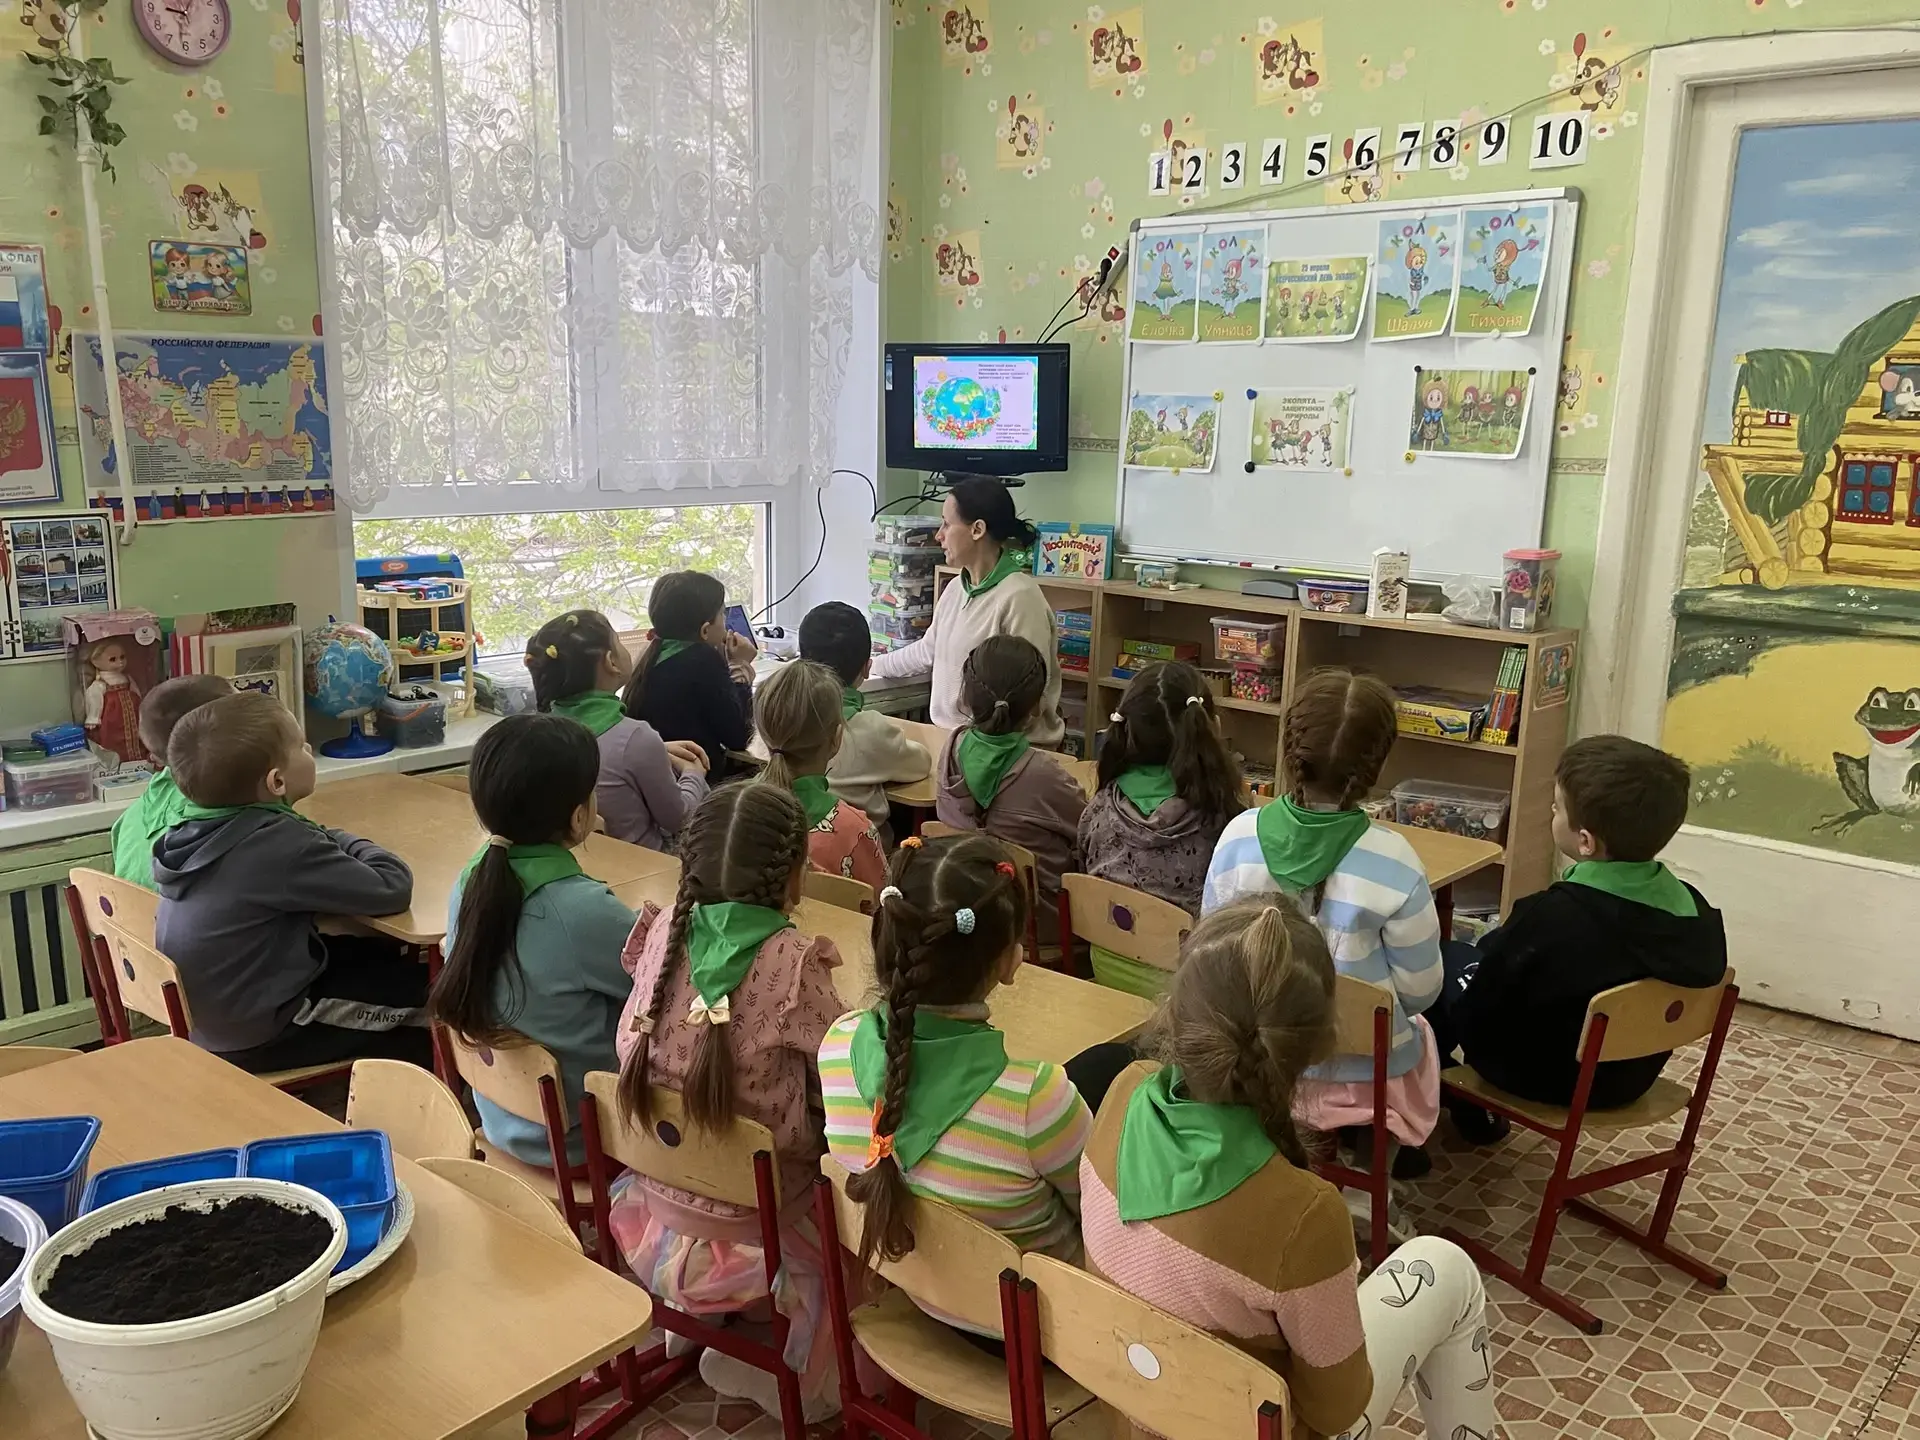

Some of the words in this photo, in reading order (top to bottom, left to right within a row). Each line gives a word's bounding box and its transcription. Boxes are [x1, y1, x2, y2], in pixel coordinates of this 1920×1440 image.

[147, 2, 155, 13] 9
[212, 13, 219, 24] 3
[154, 19, 162, 30] 8
[165, 33, 173, 44] 7
[209, 29, 216, 39] 4
[182, 41, 190, 51] 6
[199, 38, 206, 49] 5
[1152, 158, 1165, 190] 1
[1185, 155, 1202, 188] 2
[1223, 150, 1240, 183] 3
[1263, 144, 1281, 178] 4
[1307, 141, 1327, 176] 5
[1355, 135, 1377, 171] 6
[1399, 130, 1421, 167] 7
[1433, 126, 1456, 163] 8
[1482, 122, 1506, 160] 9
[1534, 118, 1583, 159] 10
[6, 252, 38, 263] ФЛАГ
[1386, 317, 1433, 333] Шалун
[1468, 312, 1523, 329] Тихоня
[1204, 324, 1253, 337] Умница
[151, 338, 213, 348] РОССИЙСКАЯ
[215, 339, 271, 349] ФЕДЕРАЦИЯ
[357, 1010, 408, 1024] UTIANST
